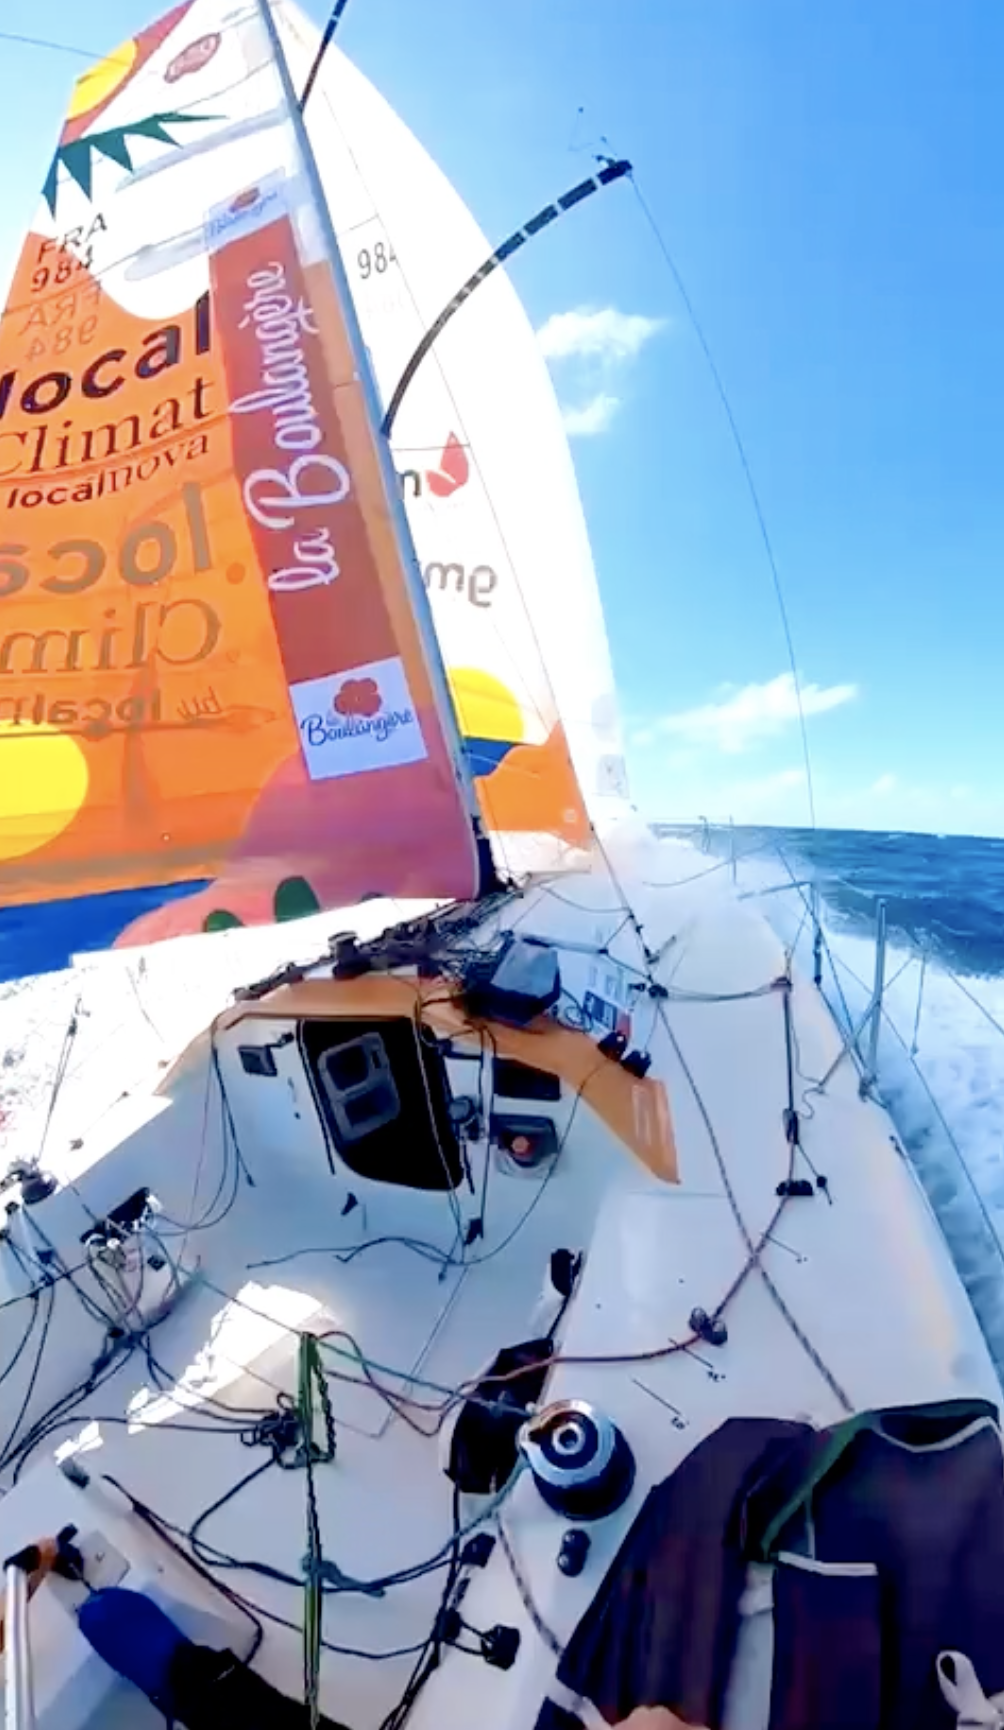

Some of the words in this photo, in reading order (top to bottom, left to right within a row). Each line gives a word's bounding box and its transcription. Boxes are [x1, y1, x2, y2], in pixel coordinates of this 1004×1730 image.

[37, 212, 107, 264] FRA
[0, 289, 210, 420] local
[7, 434, 209, 509] localnova
[268, 527, 340, 591] la
